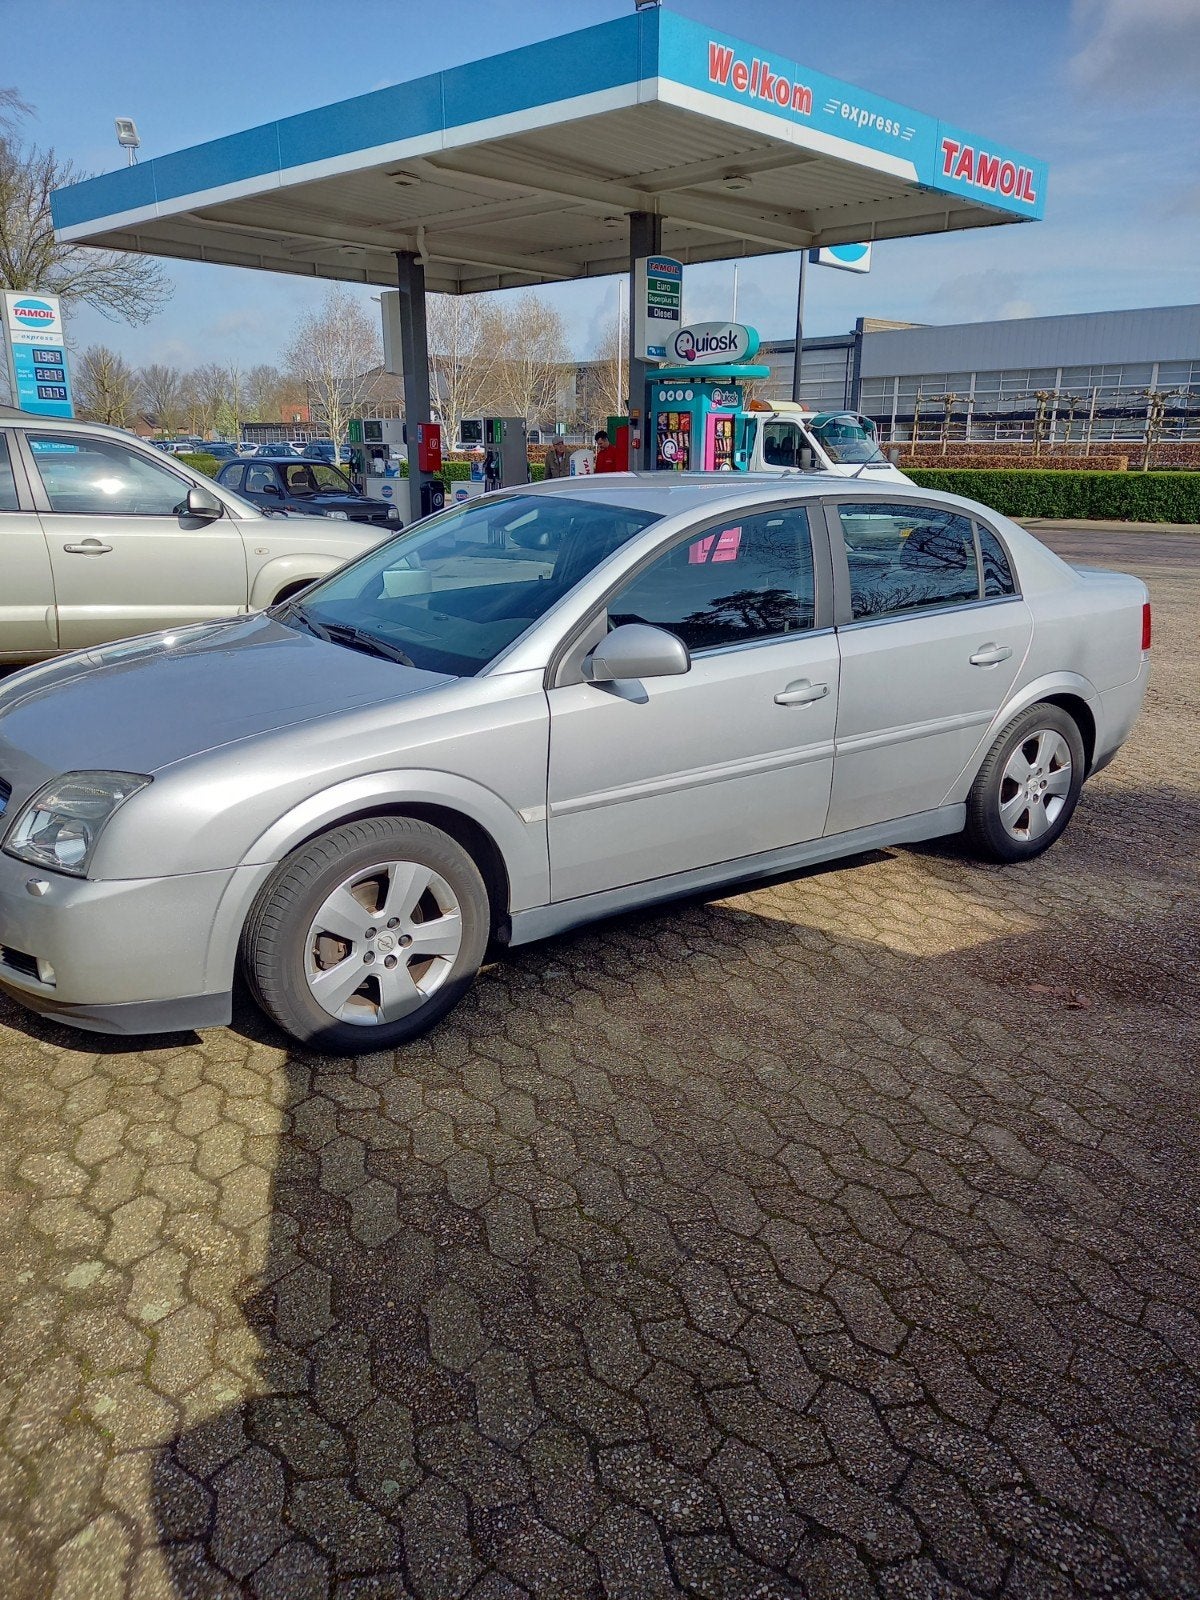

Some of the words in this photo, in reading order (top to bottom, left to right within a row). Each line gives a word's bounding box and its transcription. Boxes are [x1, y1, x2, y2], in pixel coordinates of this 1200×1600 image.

[708, 40, 813, 116] Welkom
[840, 102, 900, 137] express
[941, 137, 1036, 204] TAMOIL
[650, 262, 679, 274] TAMOIL
[656, 281, 671, 291] Euro
[13, 308, 56, 319] TAMOIL
[654, 308, 673, 319] Diesel
[674, 329, 738, 361] Quiosk
